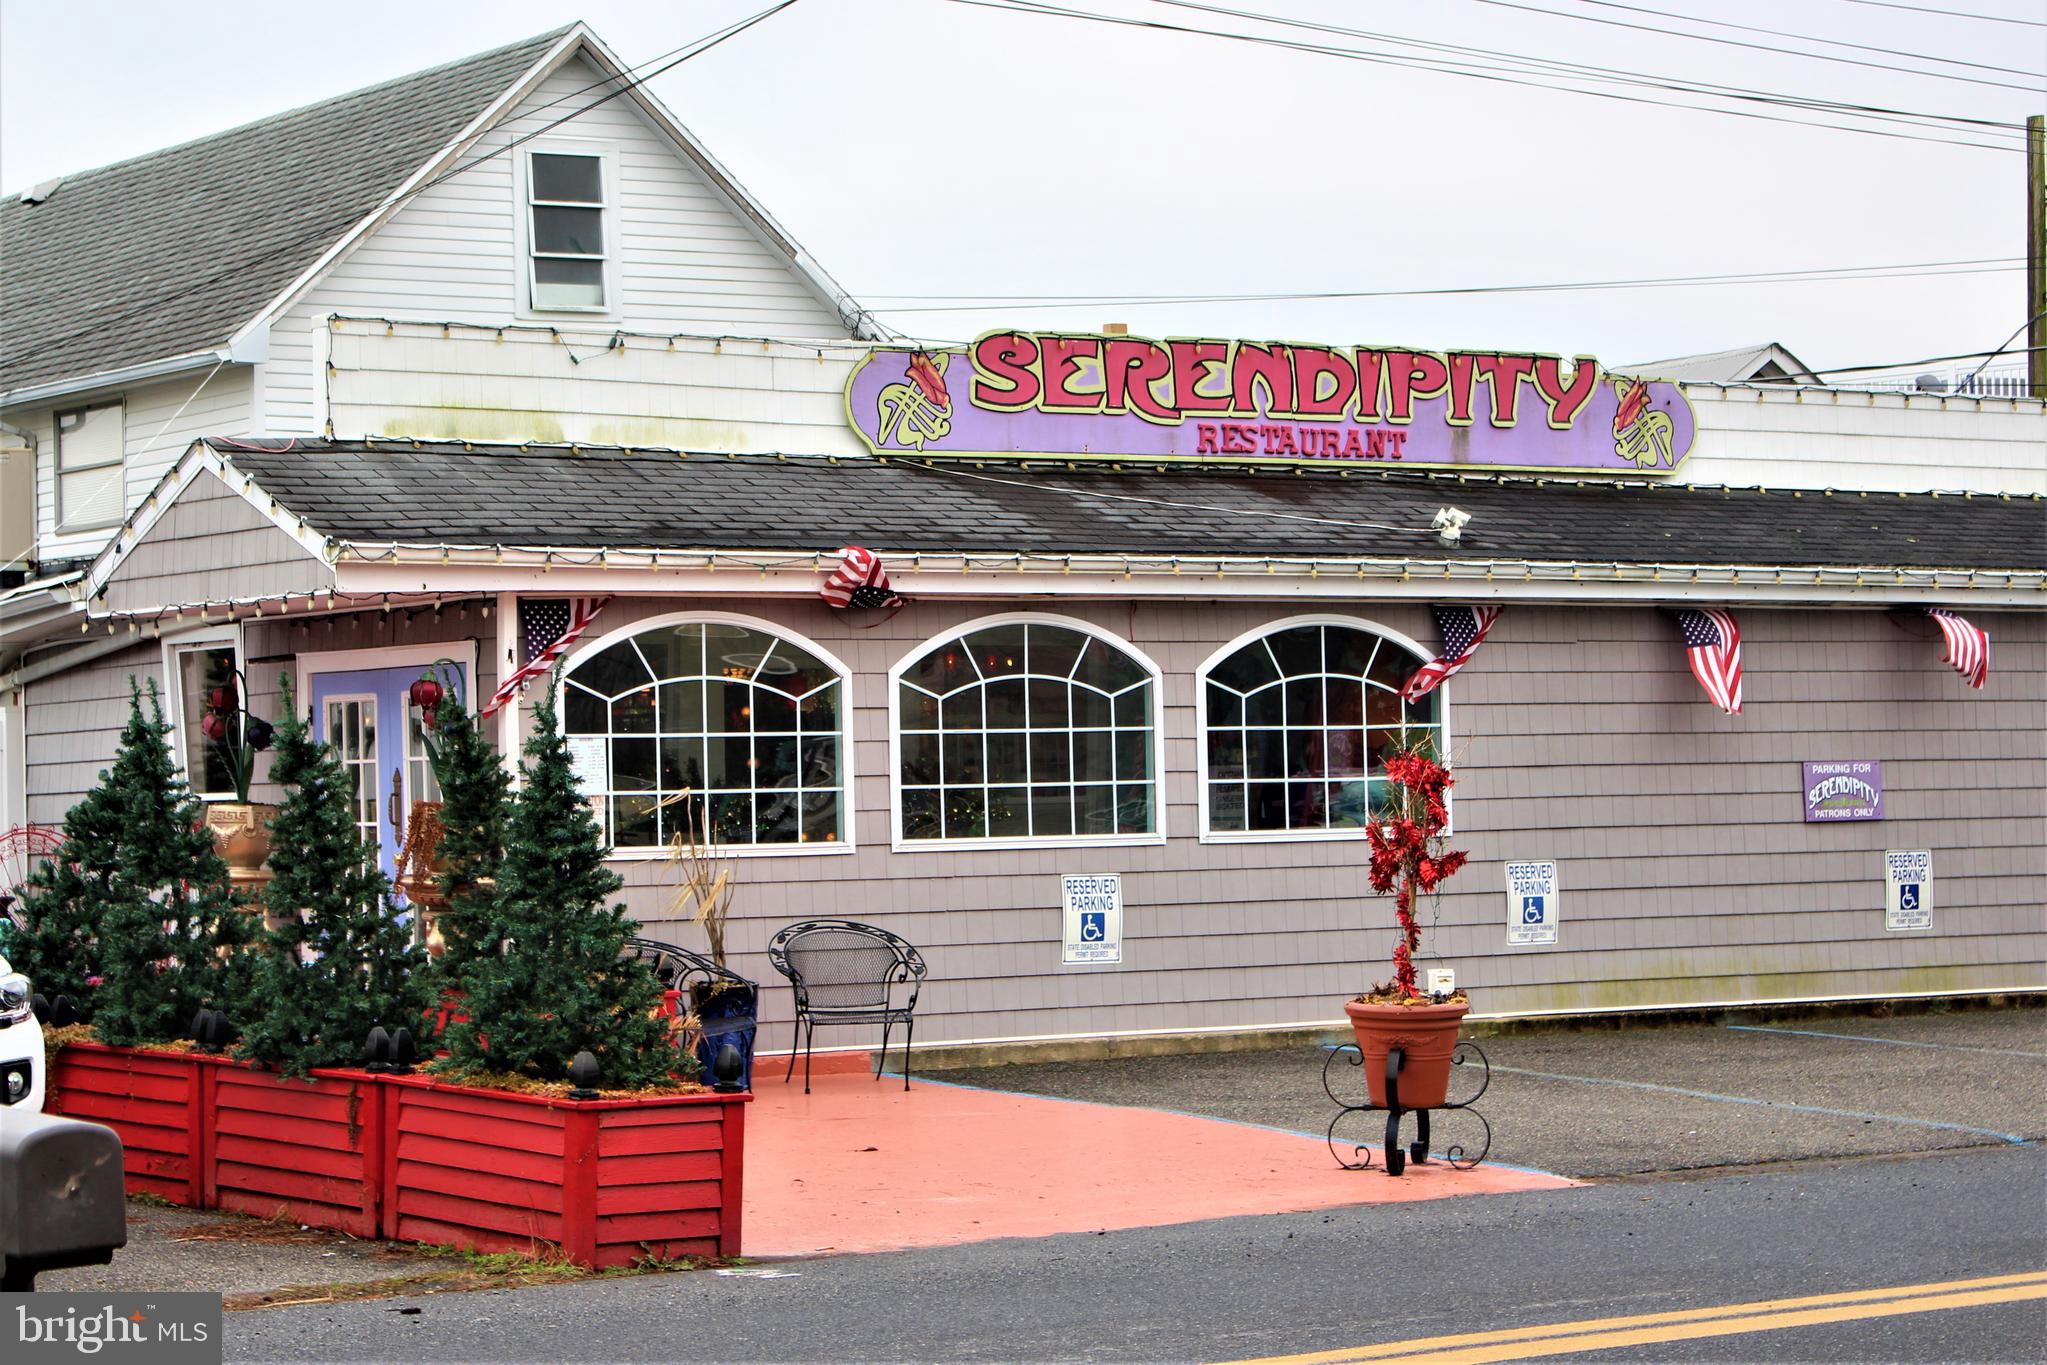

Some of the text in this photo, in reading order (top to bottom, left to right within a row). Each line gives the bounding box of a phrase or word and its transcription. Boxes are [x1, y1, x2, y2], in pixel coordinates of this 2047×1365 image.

[971, 331, 1599, 427] SERENDIPITY
[1197, 423, 1407, 460] RESTAURANT
[1812, 763, 1871, 774] PARKING FOR
[1808, 775, 1879, 810] SERENDIPITY
[1815, 807, 1874, 818] PATRONS ONLY
[1889, 854, 1928, 869] RESERVED
[1508, 865, 1553, 880] RESERVED
[1892, 868, 1926, 883] PARKING
[1066, 879, 1117, 895] RESERVED
[1513, 880, 1551, 895] PARKING
[1071, 896, 1114, 911] PARKING
